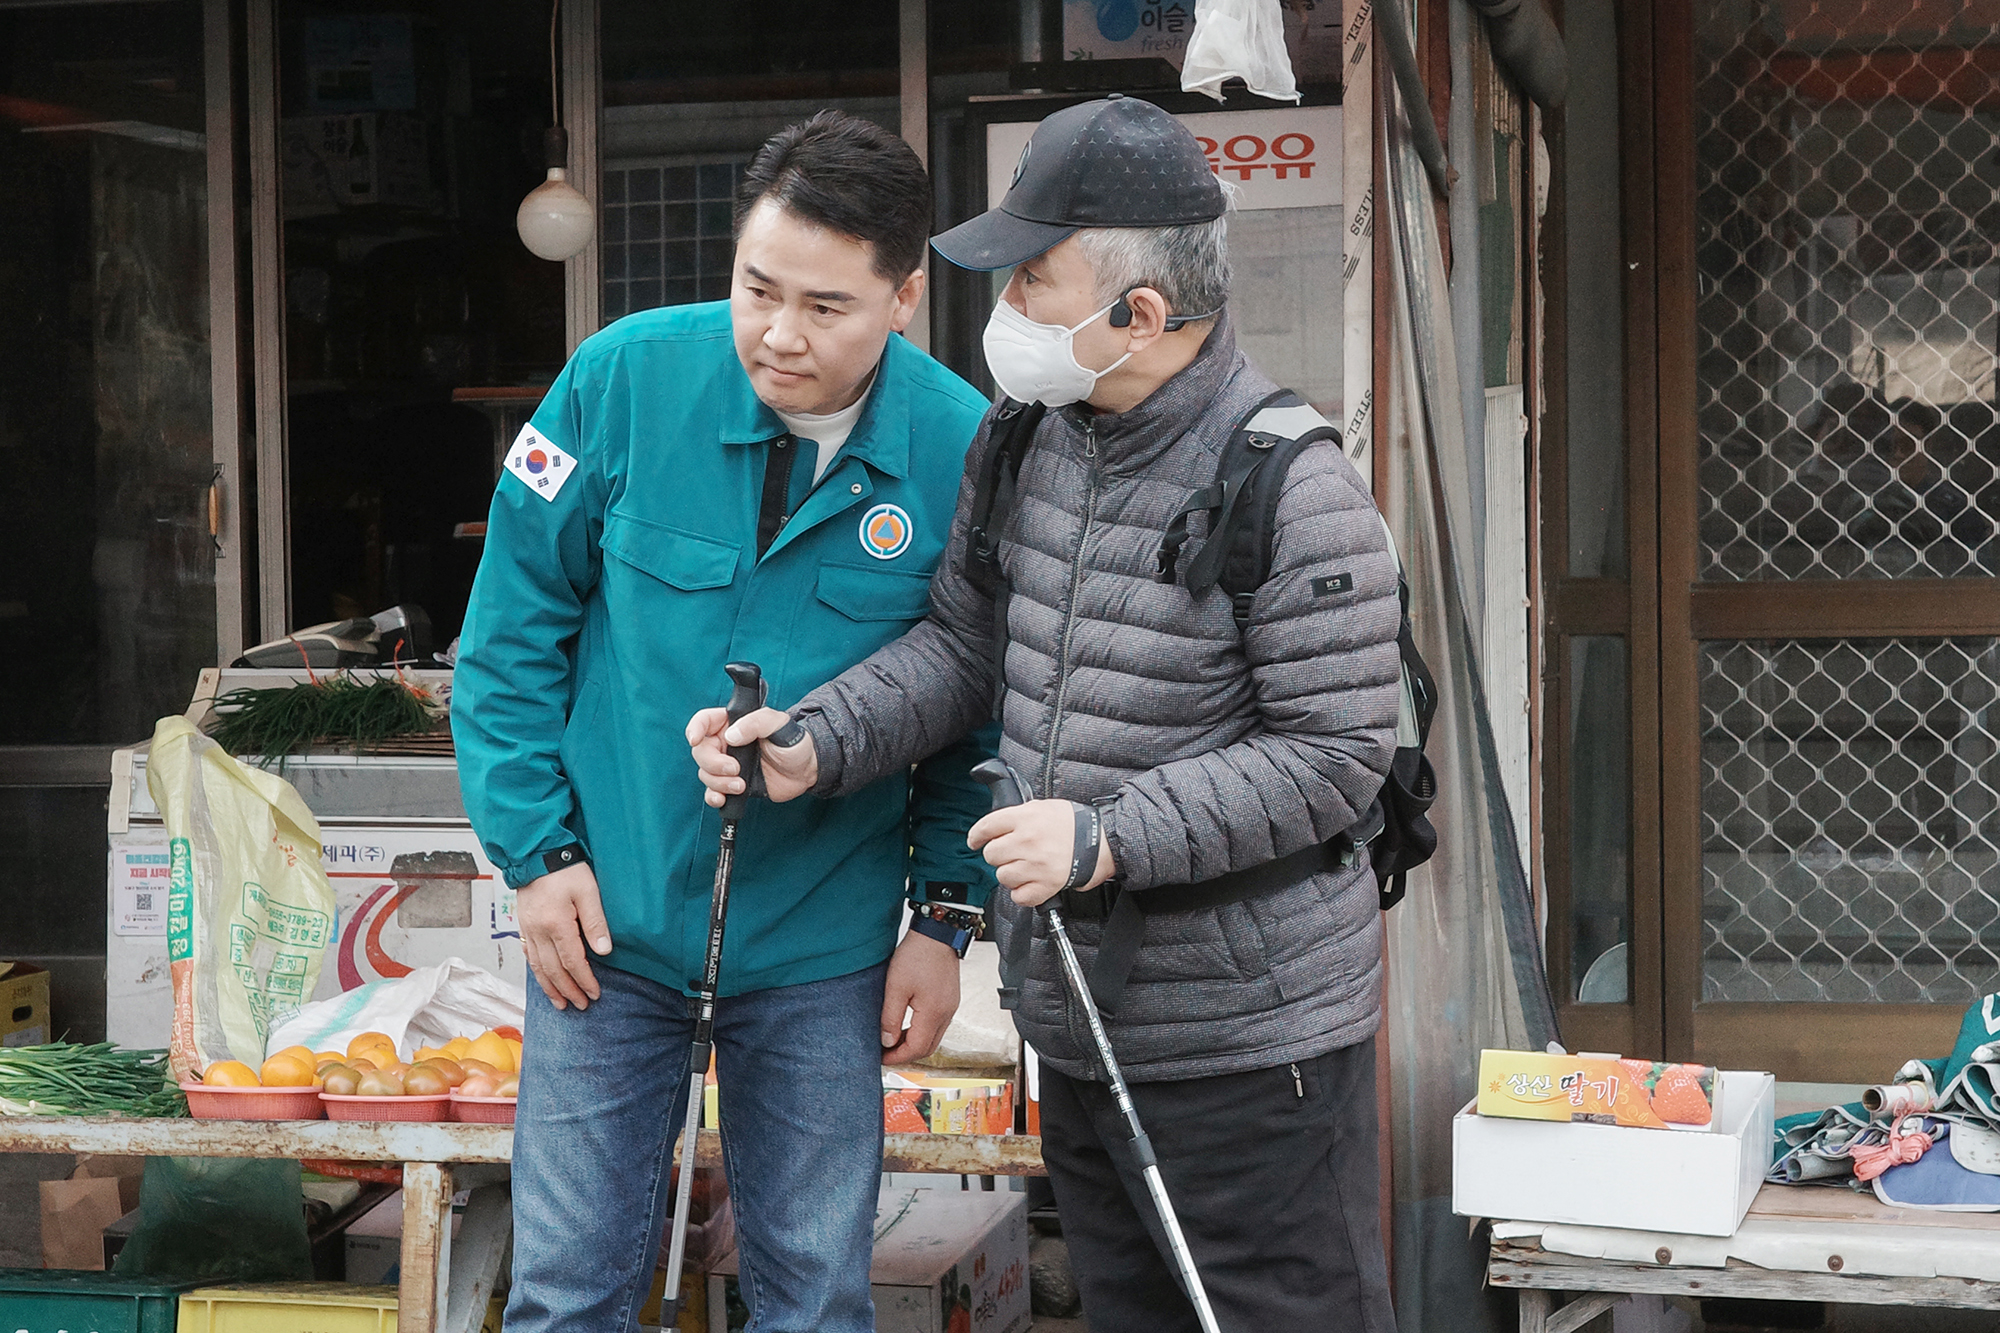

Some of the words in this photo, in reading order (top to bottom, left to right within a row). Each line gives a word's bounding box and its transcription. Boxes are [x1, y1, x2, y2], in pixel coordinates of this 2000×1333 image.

[1140, 36, 1184, 51] fresh
[1325, 578, 1342, 589] K2
[1559, 1070, 1620, 1108] 딸기
